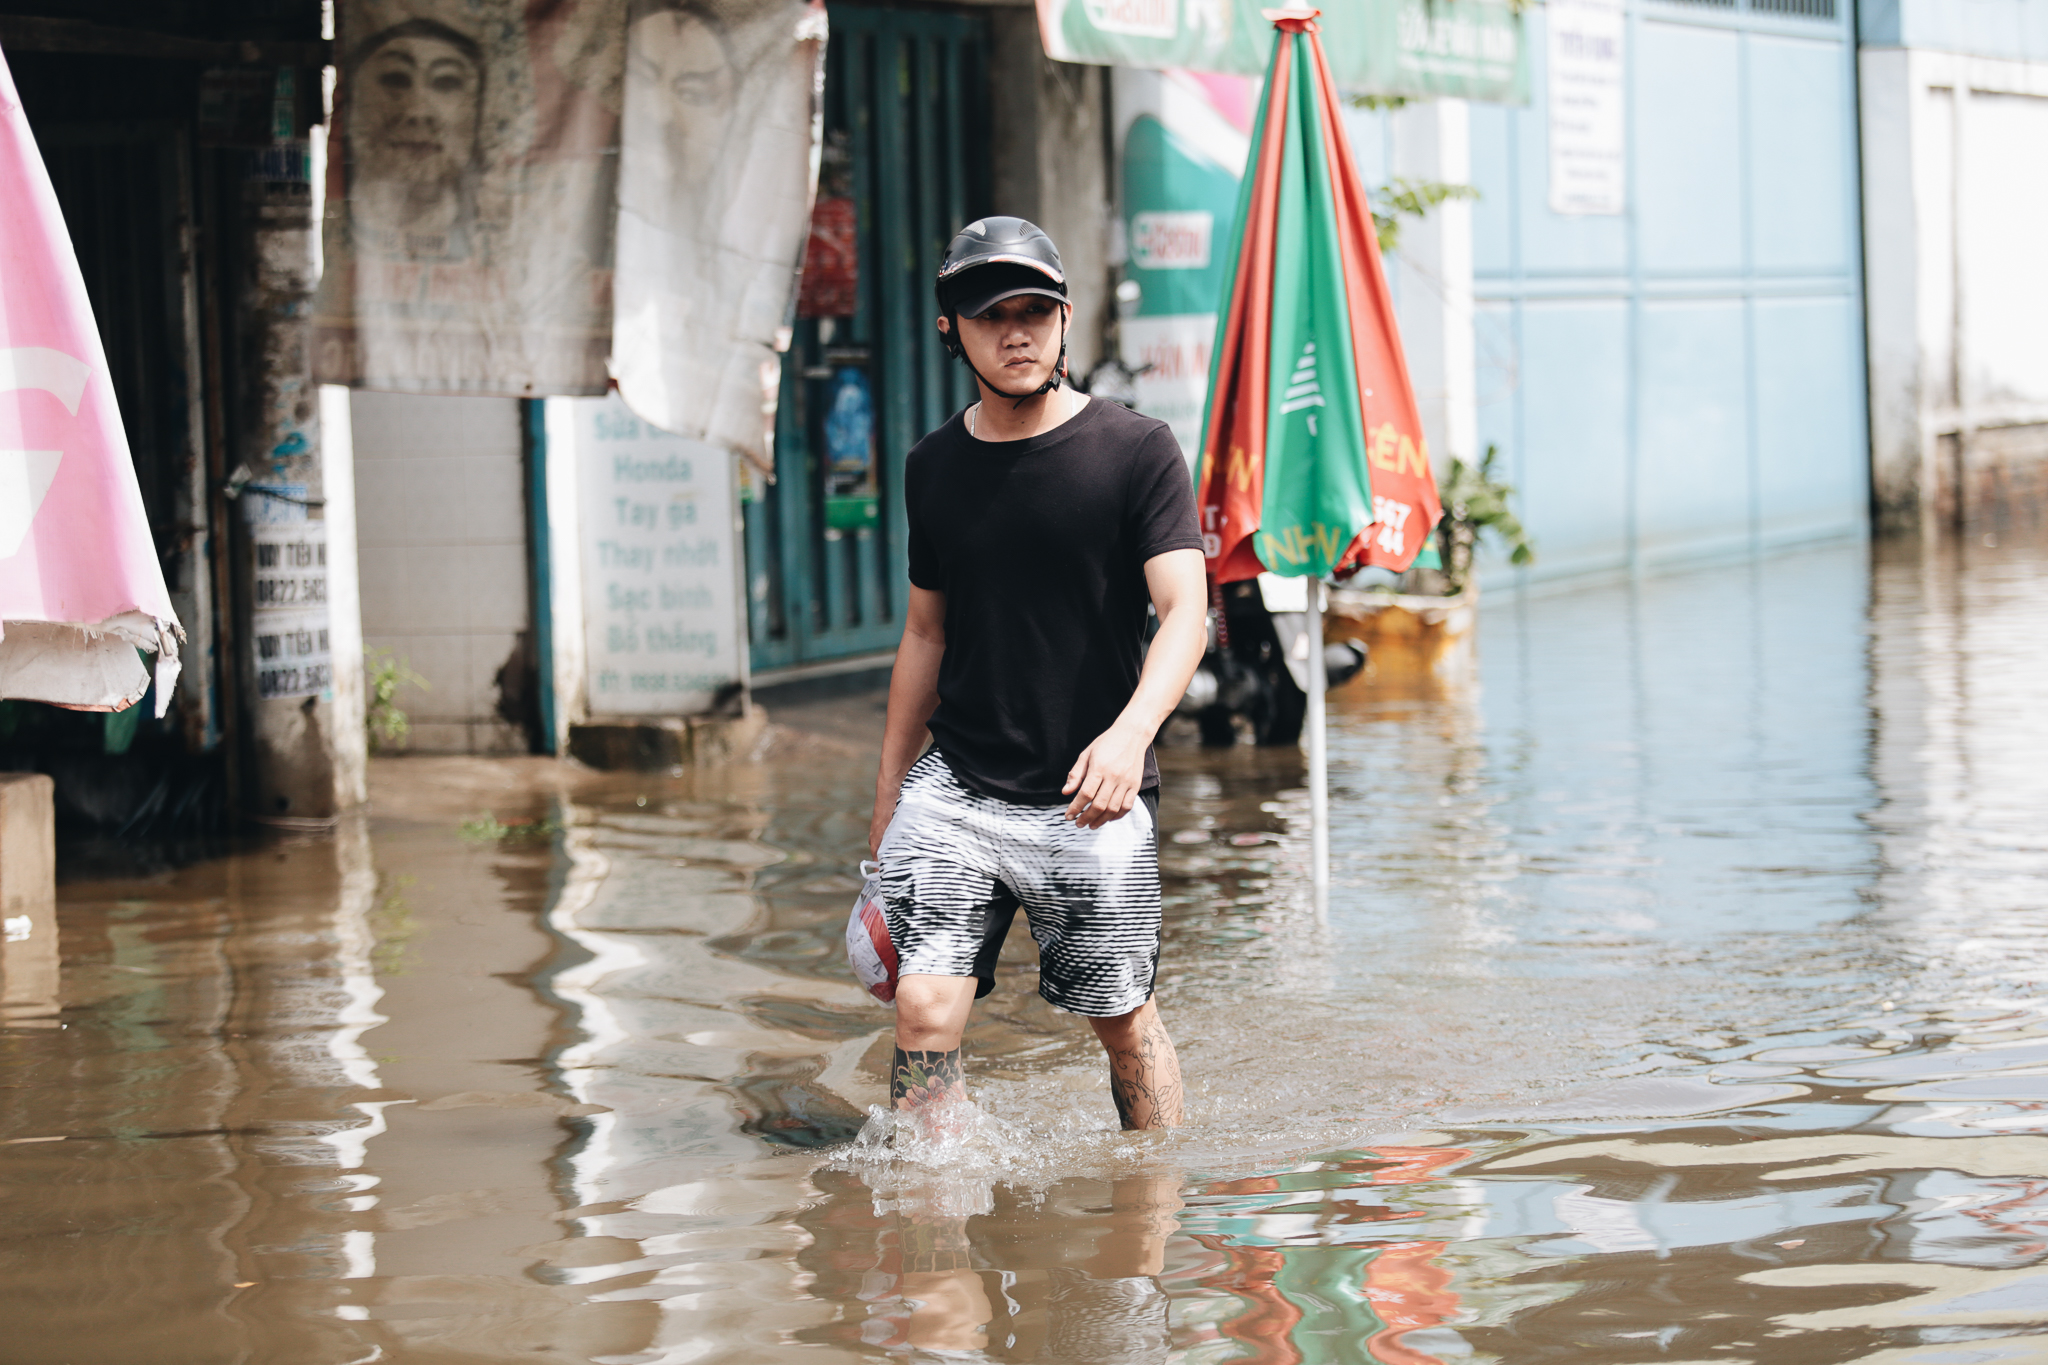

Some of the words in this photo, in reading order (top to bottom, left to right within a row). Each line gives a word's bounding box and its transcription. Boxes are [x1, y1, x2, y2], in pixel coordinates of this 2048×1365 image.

[614, 453, 693, 482] Honda
[614, 497, 657, 531] Tay
[667, 502, 697, 531] ga
[598, 540, 653, 574] Thay
